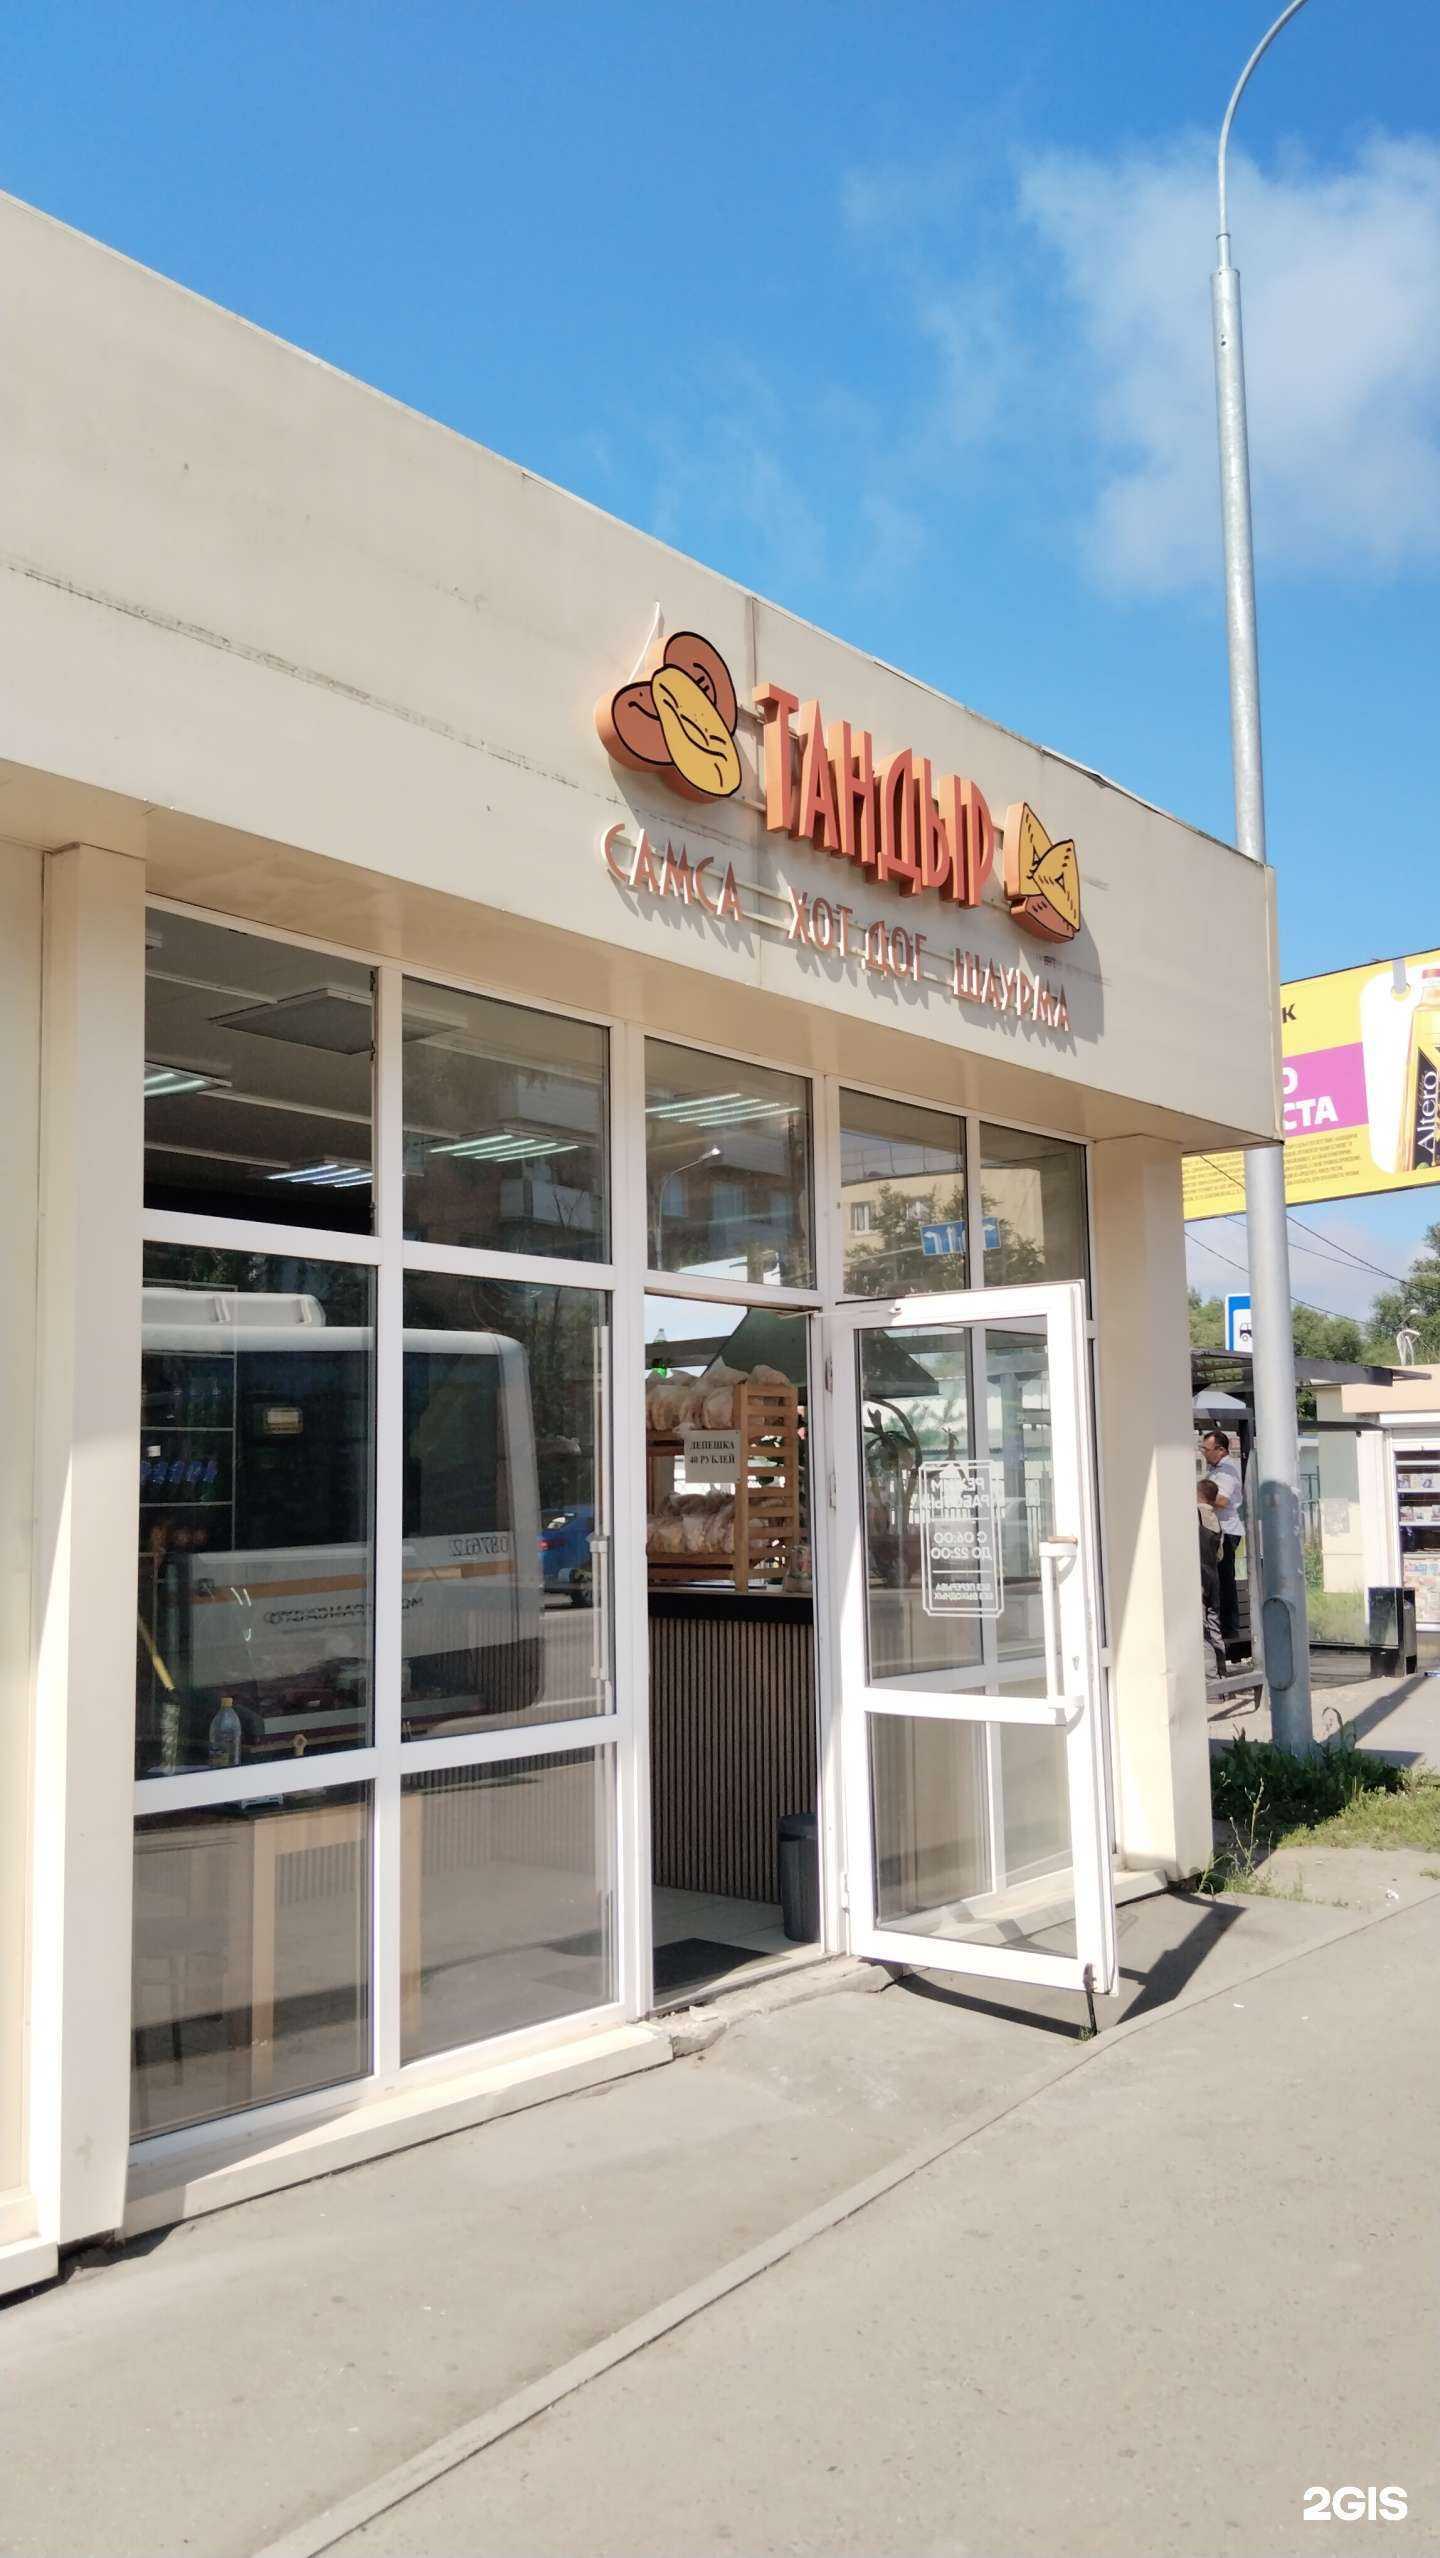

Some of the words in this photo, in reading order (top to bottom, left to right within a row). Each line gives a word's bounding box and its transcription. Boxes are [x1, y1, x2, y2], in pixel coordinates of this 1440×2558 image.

[752, 683, 994, 907] ТАНДЫР
[600, 823, 742, 921] САМСА
[787, 886, 853, 957] ХОТ
[861, 920, 927, 982] ДОГ
[953, 948, 1070, 1032] ШАУРМА
[1416, 1070, 1439, 1155] Altero
[689, 1440, 735, 1450] ЛЕПЕШКА
[700, 1453, 735, 1464] РУБЛЕЙ
